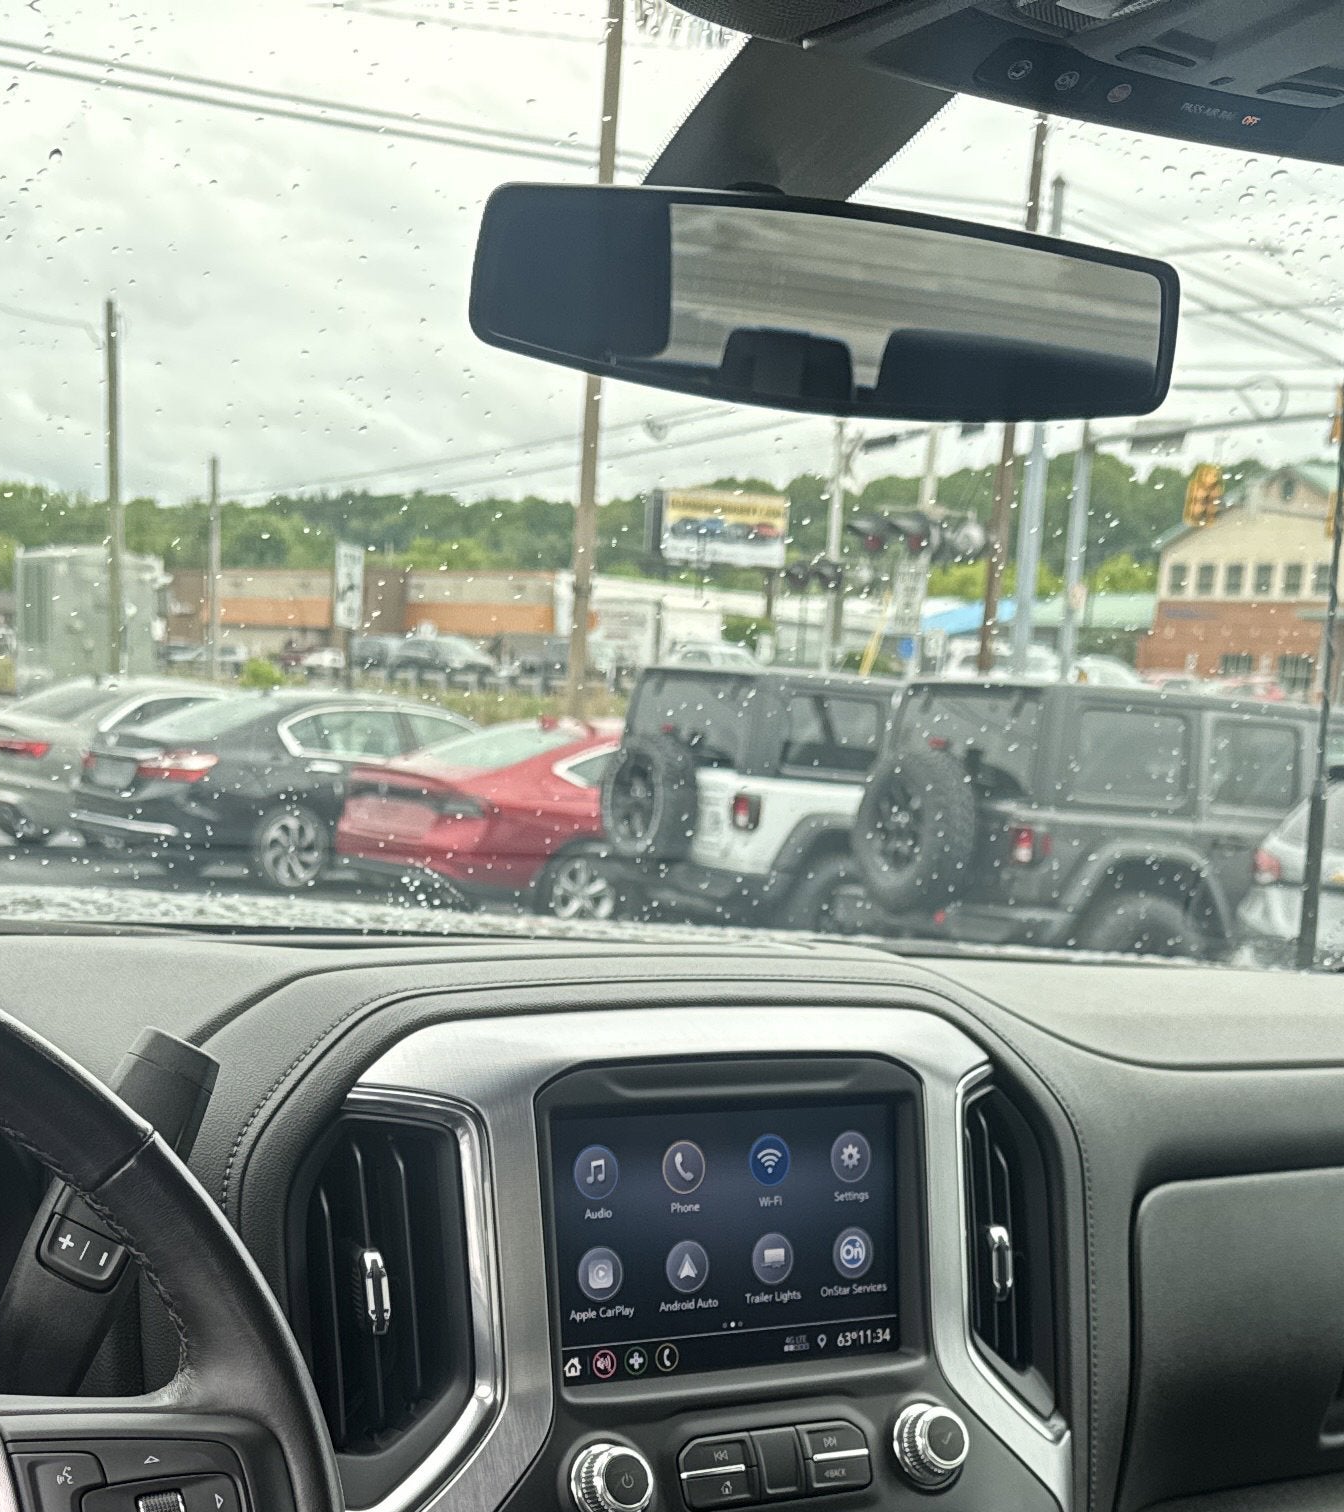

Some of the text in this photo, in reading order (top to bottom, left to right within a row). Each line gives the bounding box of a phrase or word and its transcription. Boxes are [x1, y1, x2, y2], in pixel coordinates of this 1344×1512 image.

[1241, 115, 1261, 127] OFF
[759, 1196, 783, 1207] Wi-Fi
[834, 1191, 869, 1203] Settings
[670, 1202, 700, 1213] Phone
[584, 1208, 613, 1220] Audio
[820, 1283, 888, 1298] OnStar Services
[745, 1290, 802, 1304] Trailer Lights
[659, 1298, 719, 1312] Android Auto
[569, 1305, 635, 1322] Apple CarPlay
